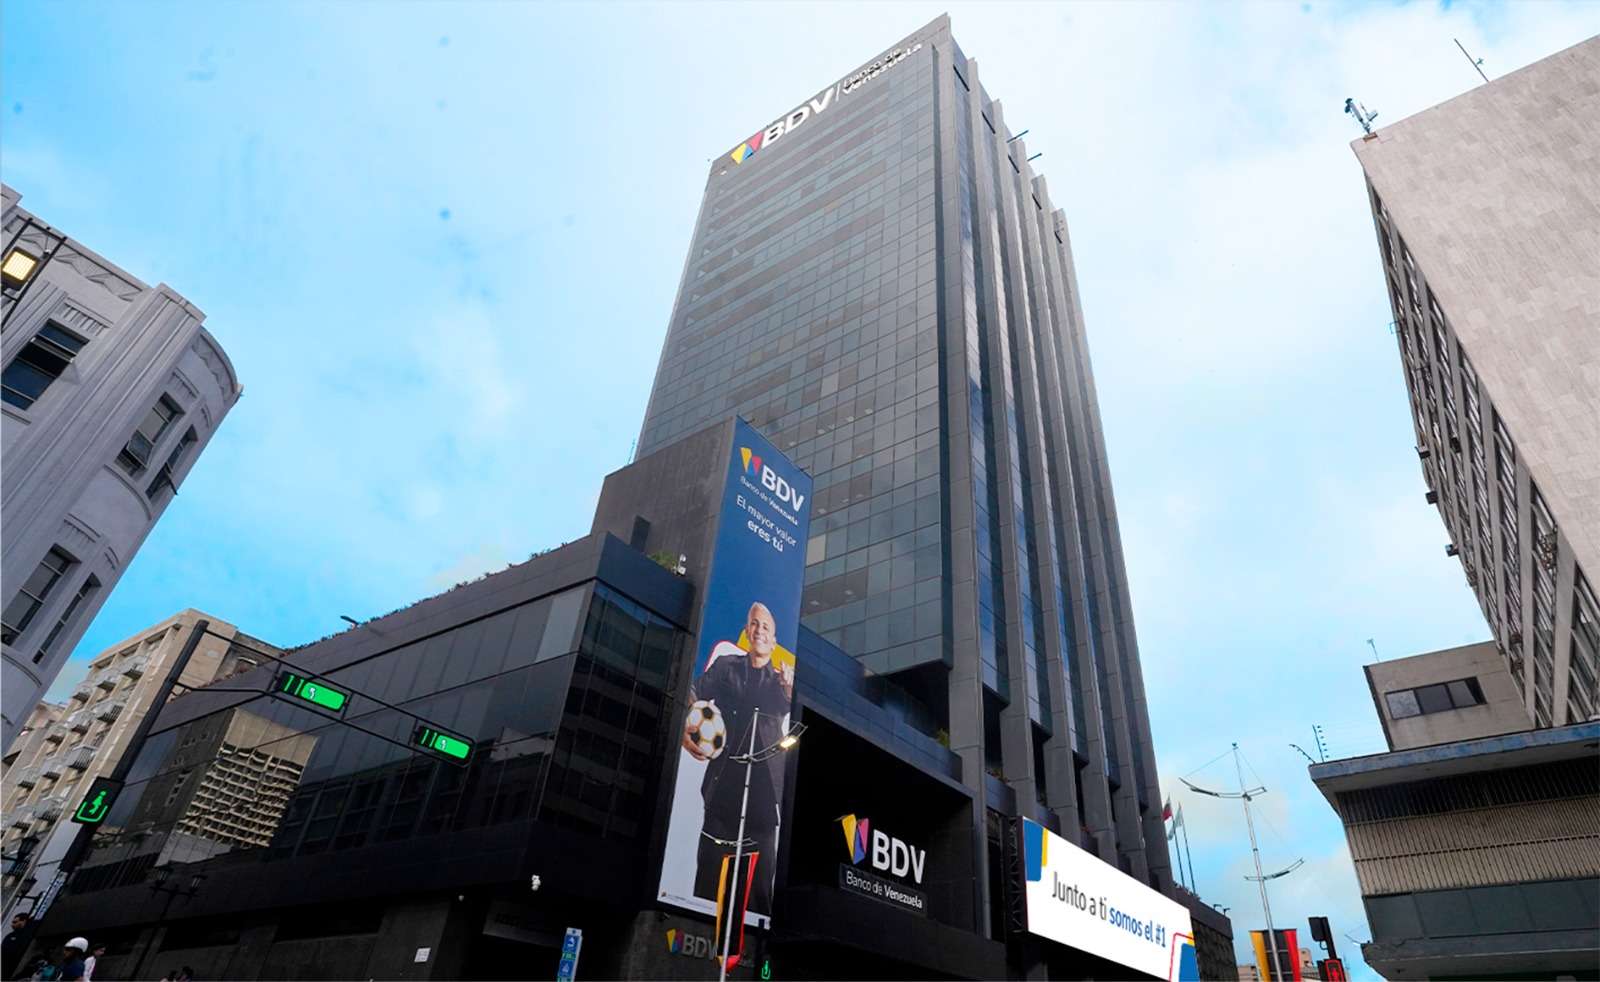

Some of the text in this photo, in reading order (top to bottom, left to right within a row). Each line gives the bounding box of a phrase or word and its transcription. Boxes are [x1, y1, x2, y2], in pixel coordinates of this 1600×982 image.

[761, 87, 835, 149] BDV
[761, 464, 805, 512] BDV
[736, 494, 797, 547] El mayor valor
[747, 519, 784, 552] eres tú
[872, 828, 926, 884] BDV
[846, 870, 923, 909] Banco de Venezuela
[1051, 871, 1167, 948] Junto a ti somos el #1
